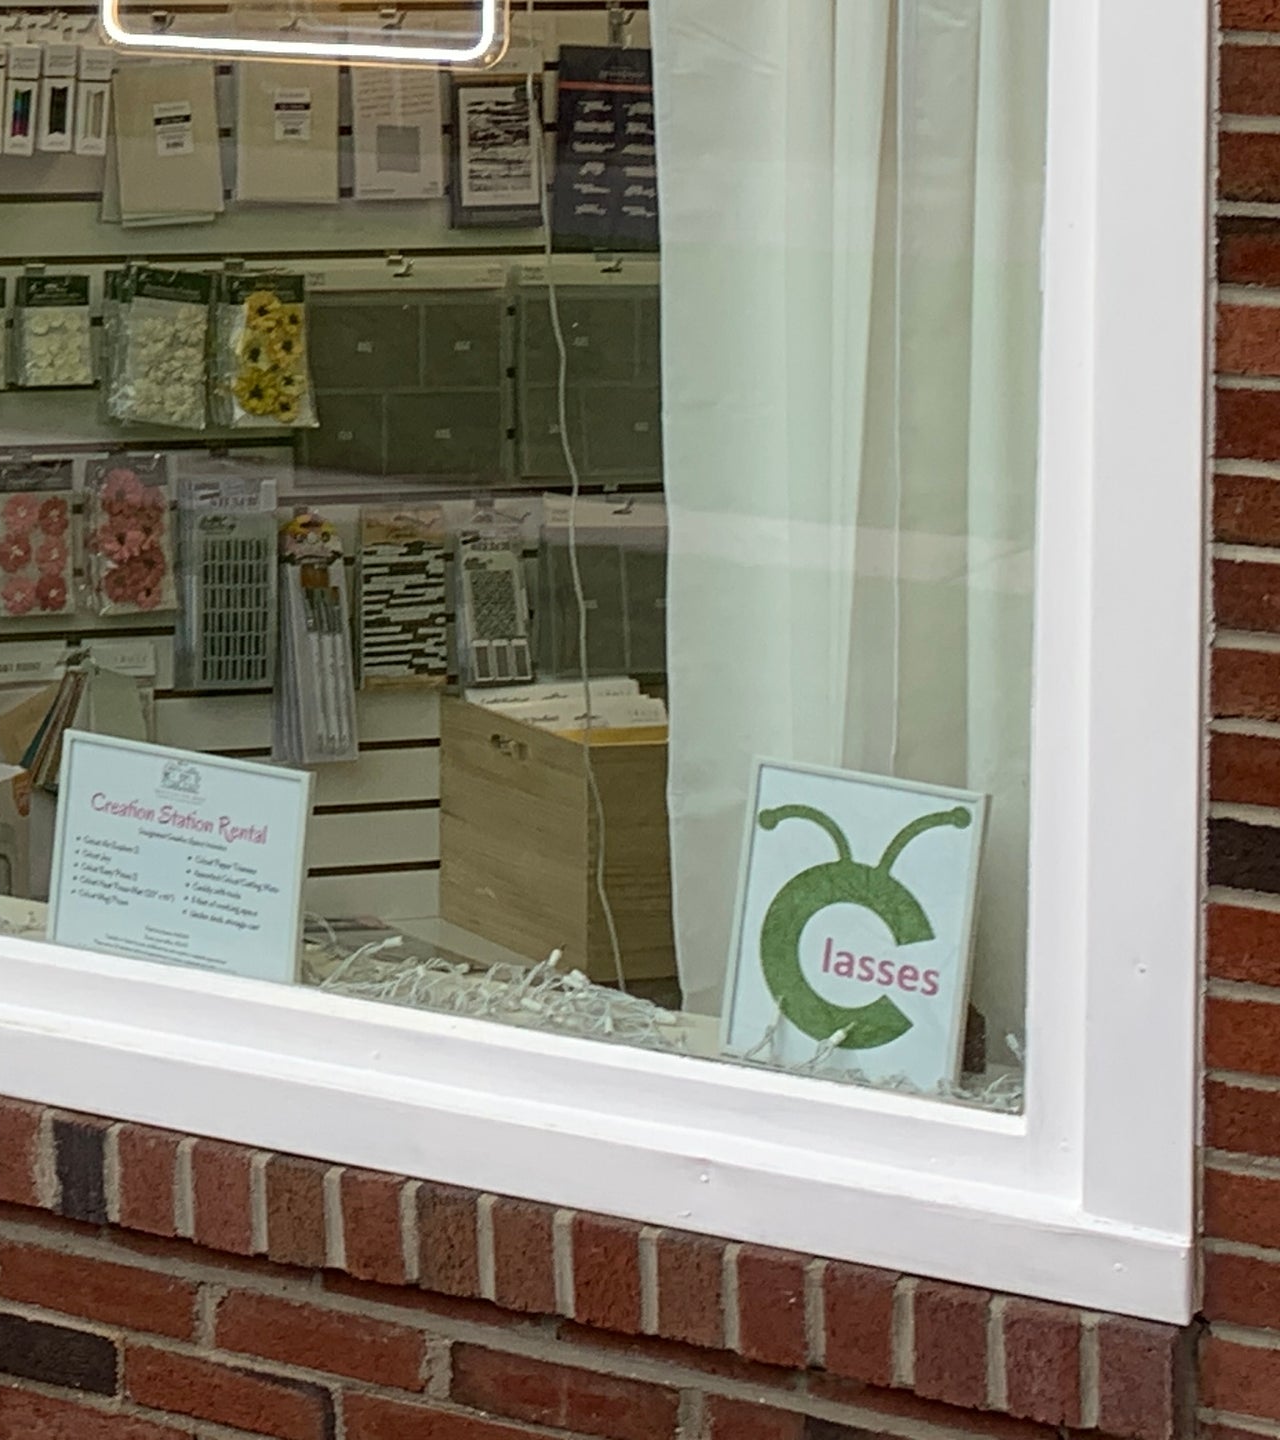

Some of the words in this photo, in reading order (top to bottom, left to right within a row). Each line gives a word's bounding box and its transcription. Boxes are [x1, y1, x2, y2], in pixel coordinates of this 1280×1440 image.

[91, 791, 156, 822] Creation
[157, 805, 214, 835] Station
[218, 815, 270, 846] Rental
